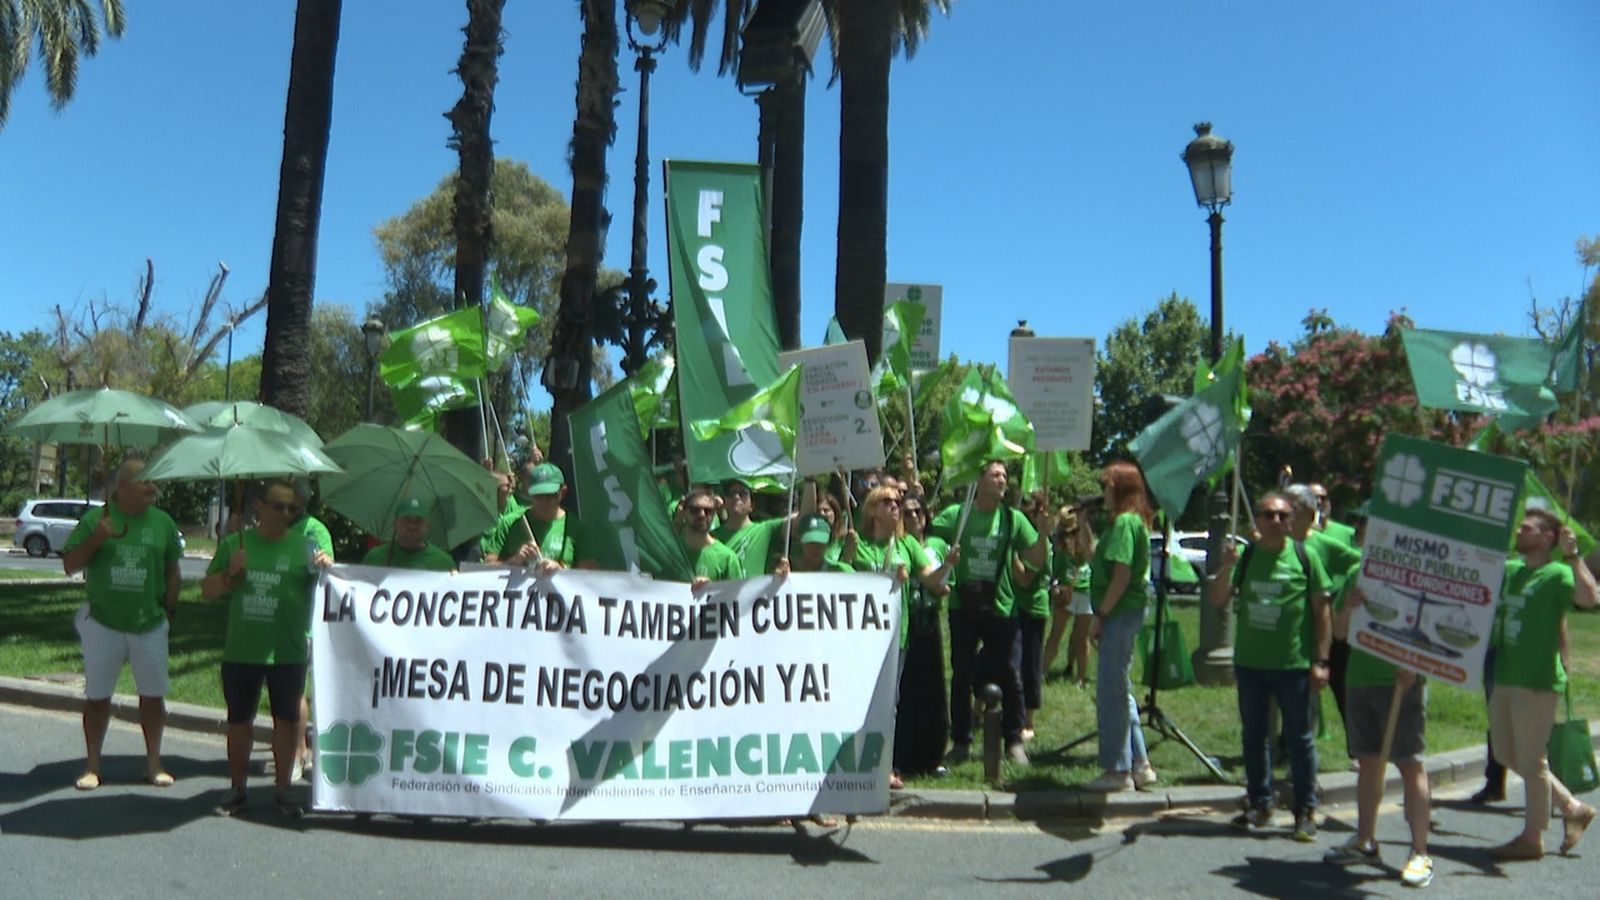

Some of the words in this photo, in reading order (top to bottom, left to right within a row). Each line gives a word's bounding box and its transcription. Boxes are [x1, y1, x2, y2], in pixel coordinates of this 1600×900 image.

[1431, 474, 1516, 522] FSIE
[1368, 545, 1422, 571] SERVICIO
[1394, 533, 1450, 560] MISMO
[322, 583, 356, 622] LA
[369, 589, 587, 634] CONCERTADA
[598, 594, 740, 641] TAMBIÉN
[752, 593, 891, 634] CUENTA:
[371, 657, 471, 708] ¡MESA
[482, 661, 526, 704] DE
[536, 660, 765, 712] NEGOCIACIÓN
[776, 663, 830, 702] YA!
[389, 729, 490, 775] FSIE
[508, 735, 553, 780] C.
[391, 778, 460, 793] Federación
[465, 780, 480, 794] de
[484, 781, 552, 796] Sindicatos
[556, 784, 655, 799] Independientes
[659, 786, 676, 798] de
[680, 783, 751, 797] Enseñanza
